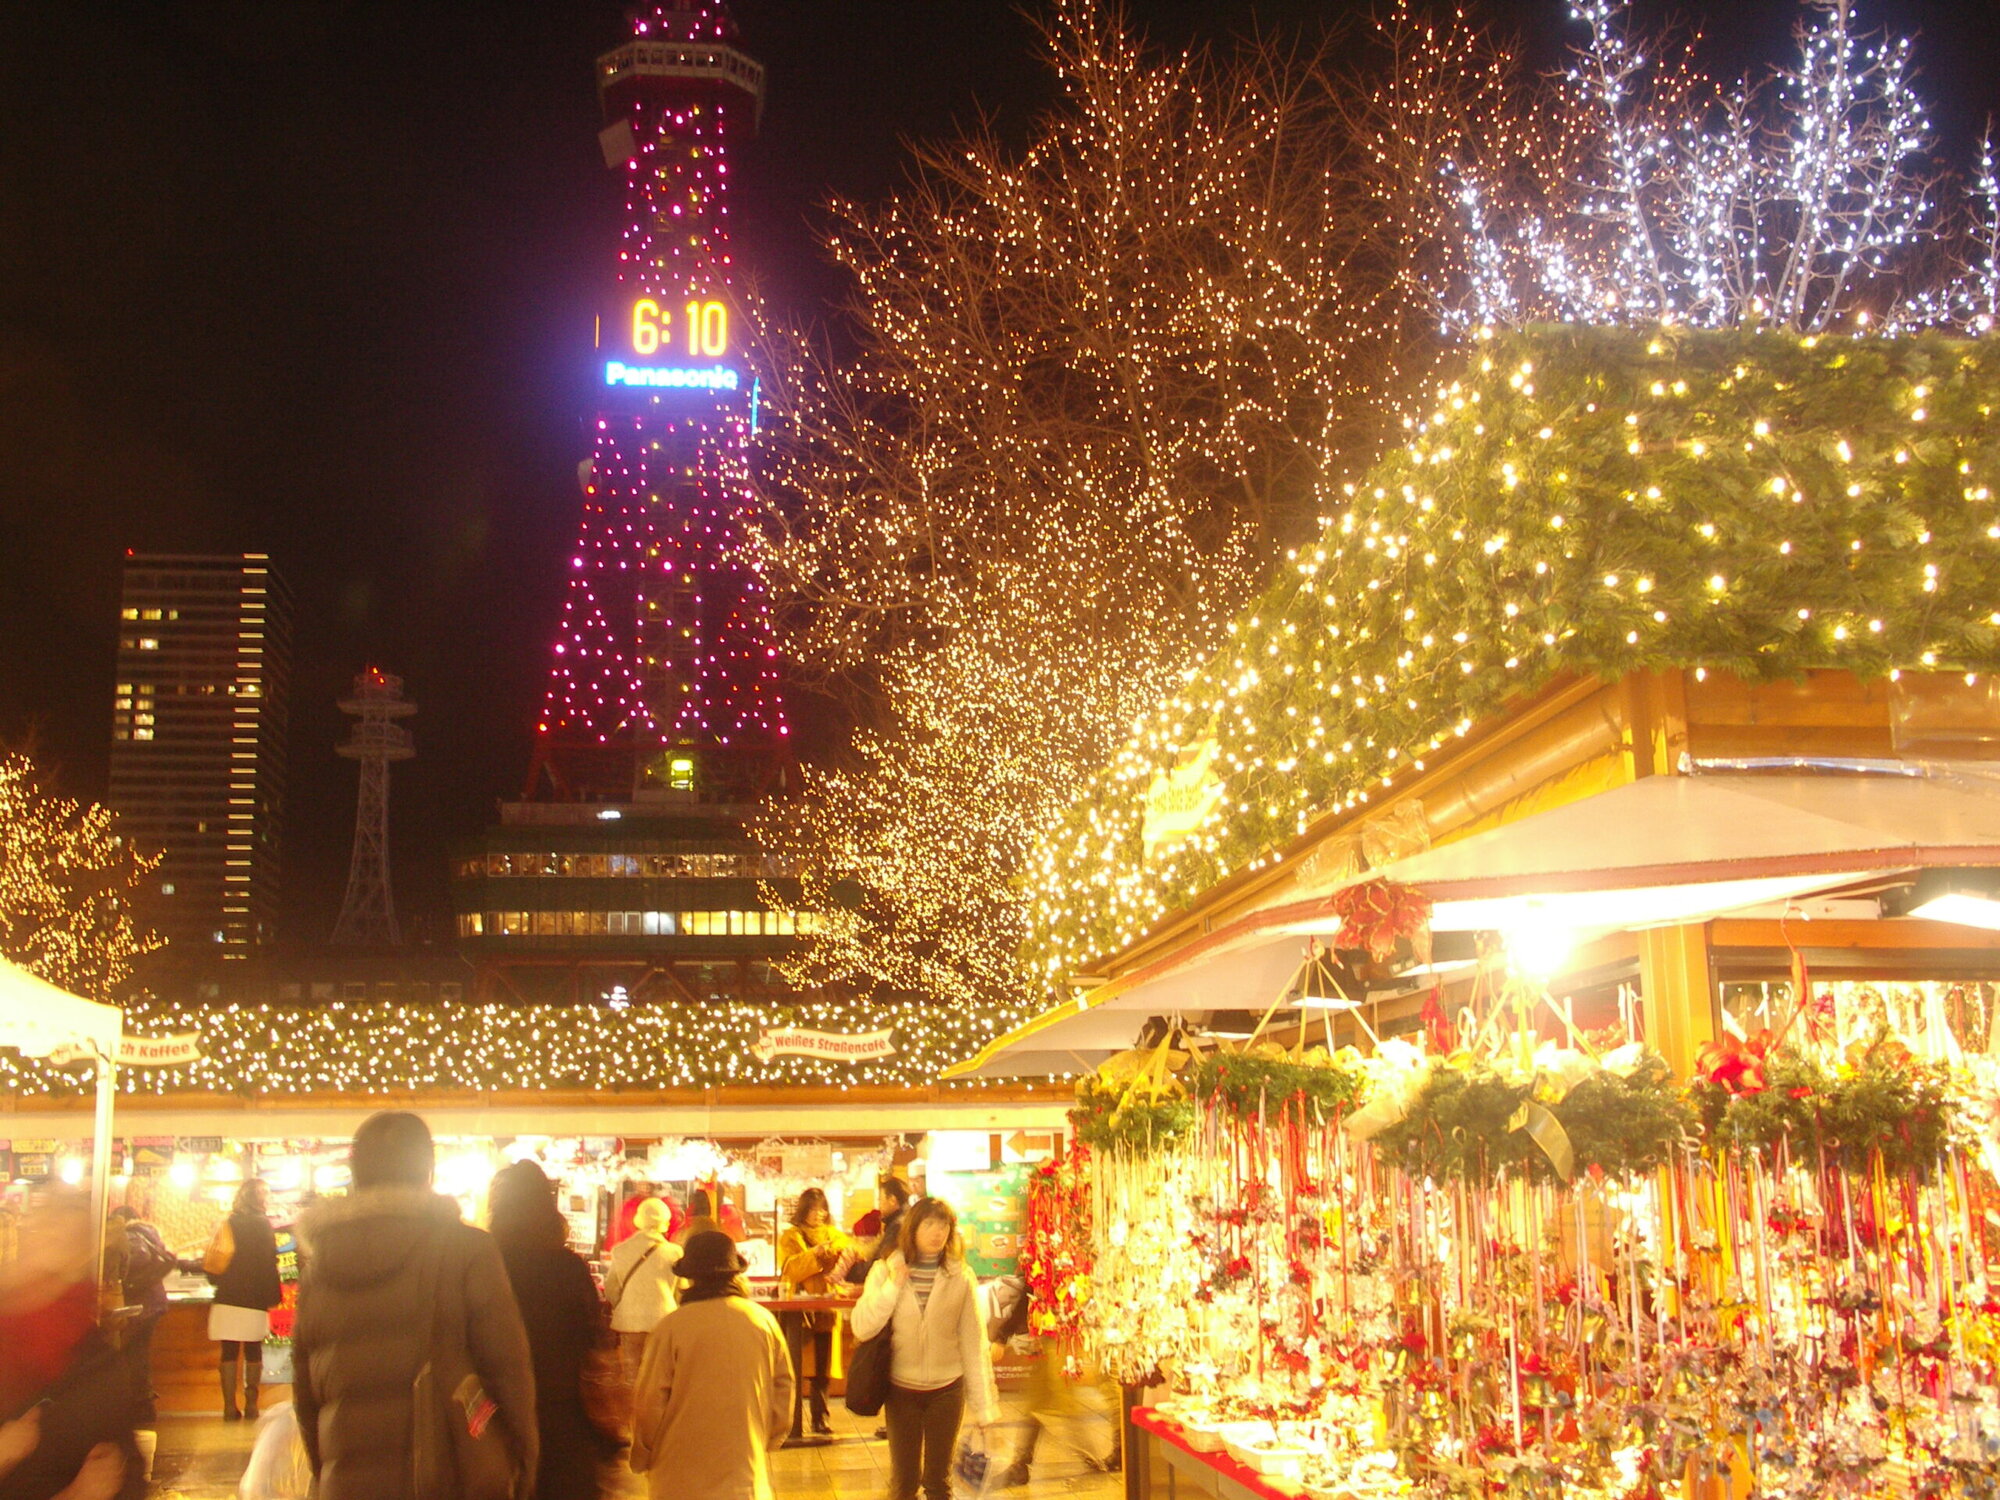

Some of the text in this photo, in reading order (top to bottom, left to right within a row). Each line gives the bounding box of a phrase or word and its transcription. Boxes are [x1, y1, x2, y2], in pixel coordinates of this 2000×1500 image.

[606, 361, 737, 388] Panasonic
[775, 1035, 815, 1048] Weißes
[140, 1043, 190, 1058] Kaffee
